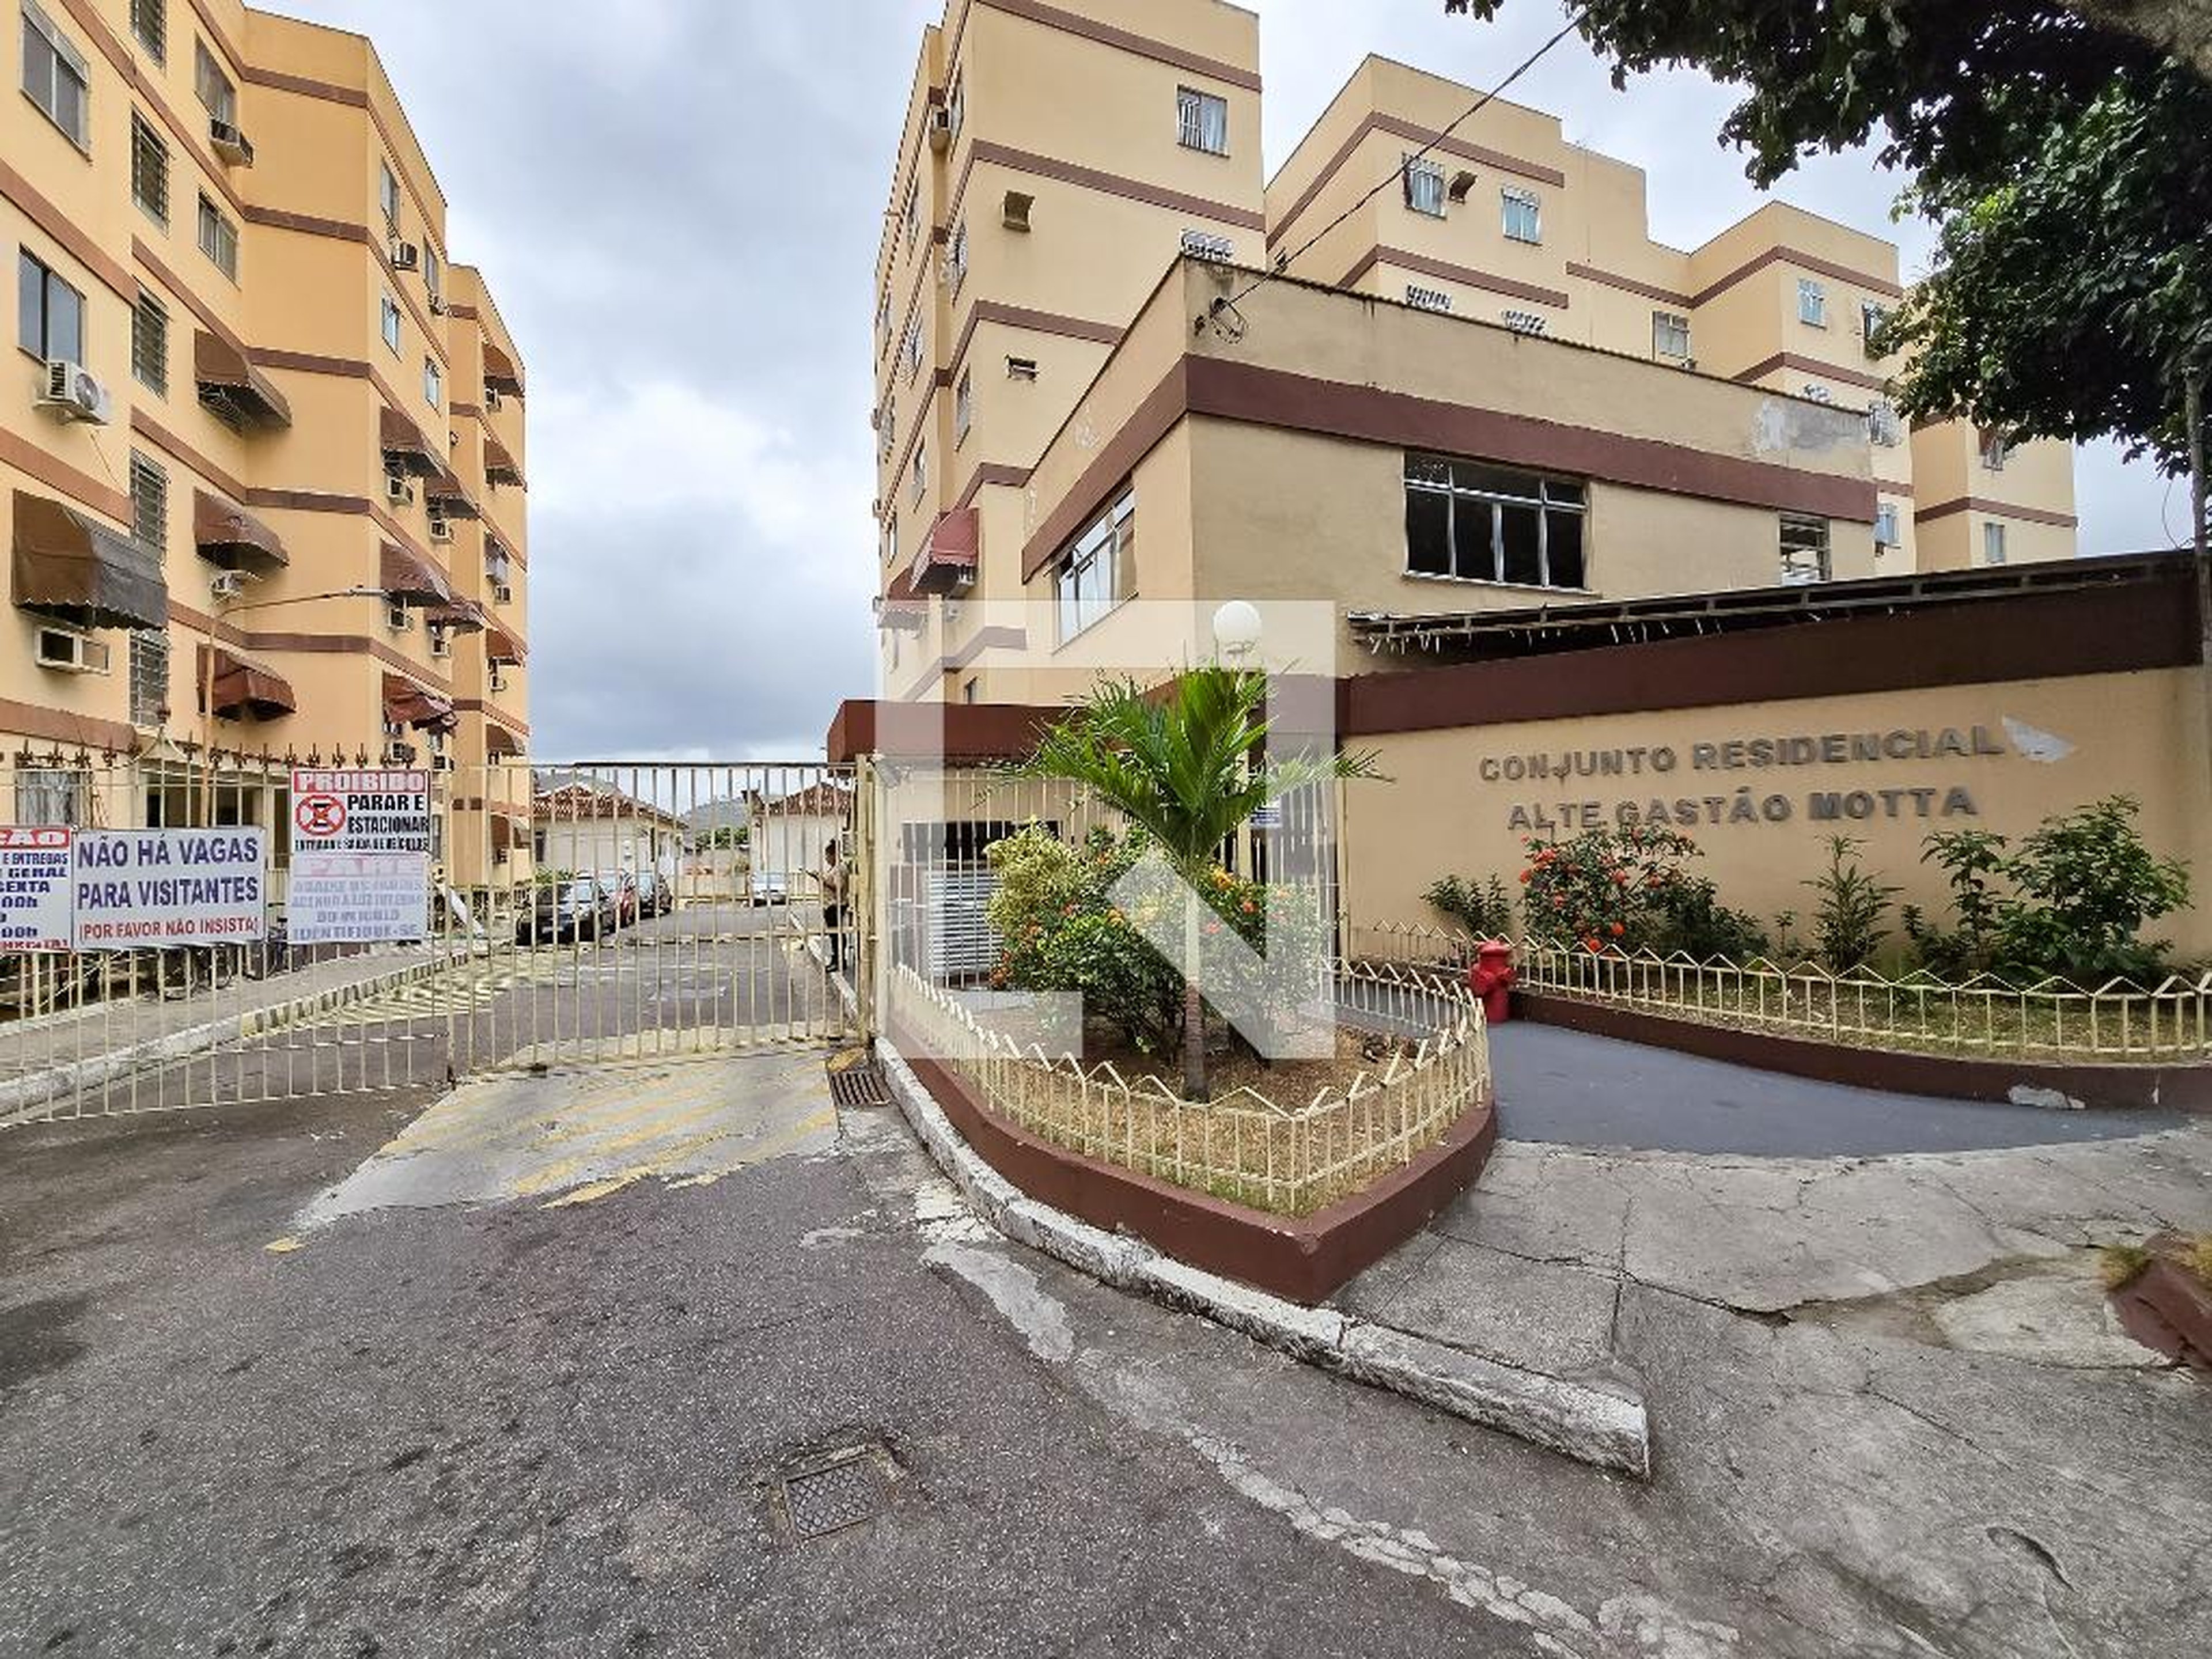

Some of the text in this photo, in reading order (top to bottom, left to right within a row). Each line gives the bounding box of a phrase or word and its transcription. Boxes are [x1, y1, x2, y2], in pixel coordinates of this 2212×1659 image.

[1480, 726, 2005, 781] CONJUNTO RESIDENCIAL
[298, 772, 425, 791] PROIBIDO
[347, 795, 425, 810] PARAR E
[1809, 786, 1979, 820] MOTTA
[347, 816, 429, 834] ESTACIONAR
[12, 853, 68, 865] ENTREGAS
[78, 834, 258, 869] NÃO HÁ VAGAS
[78, 876, 258, 910] PARA VISITANTES
[117, 921, 161, 938] FAVOR
